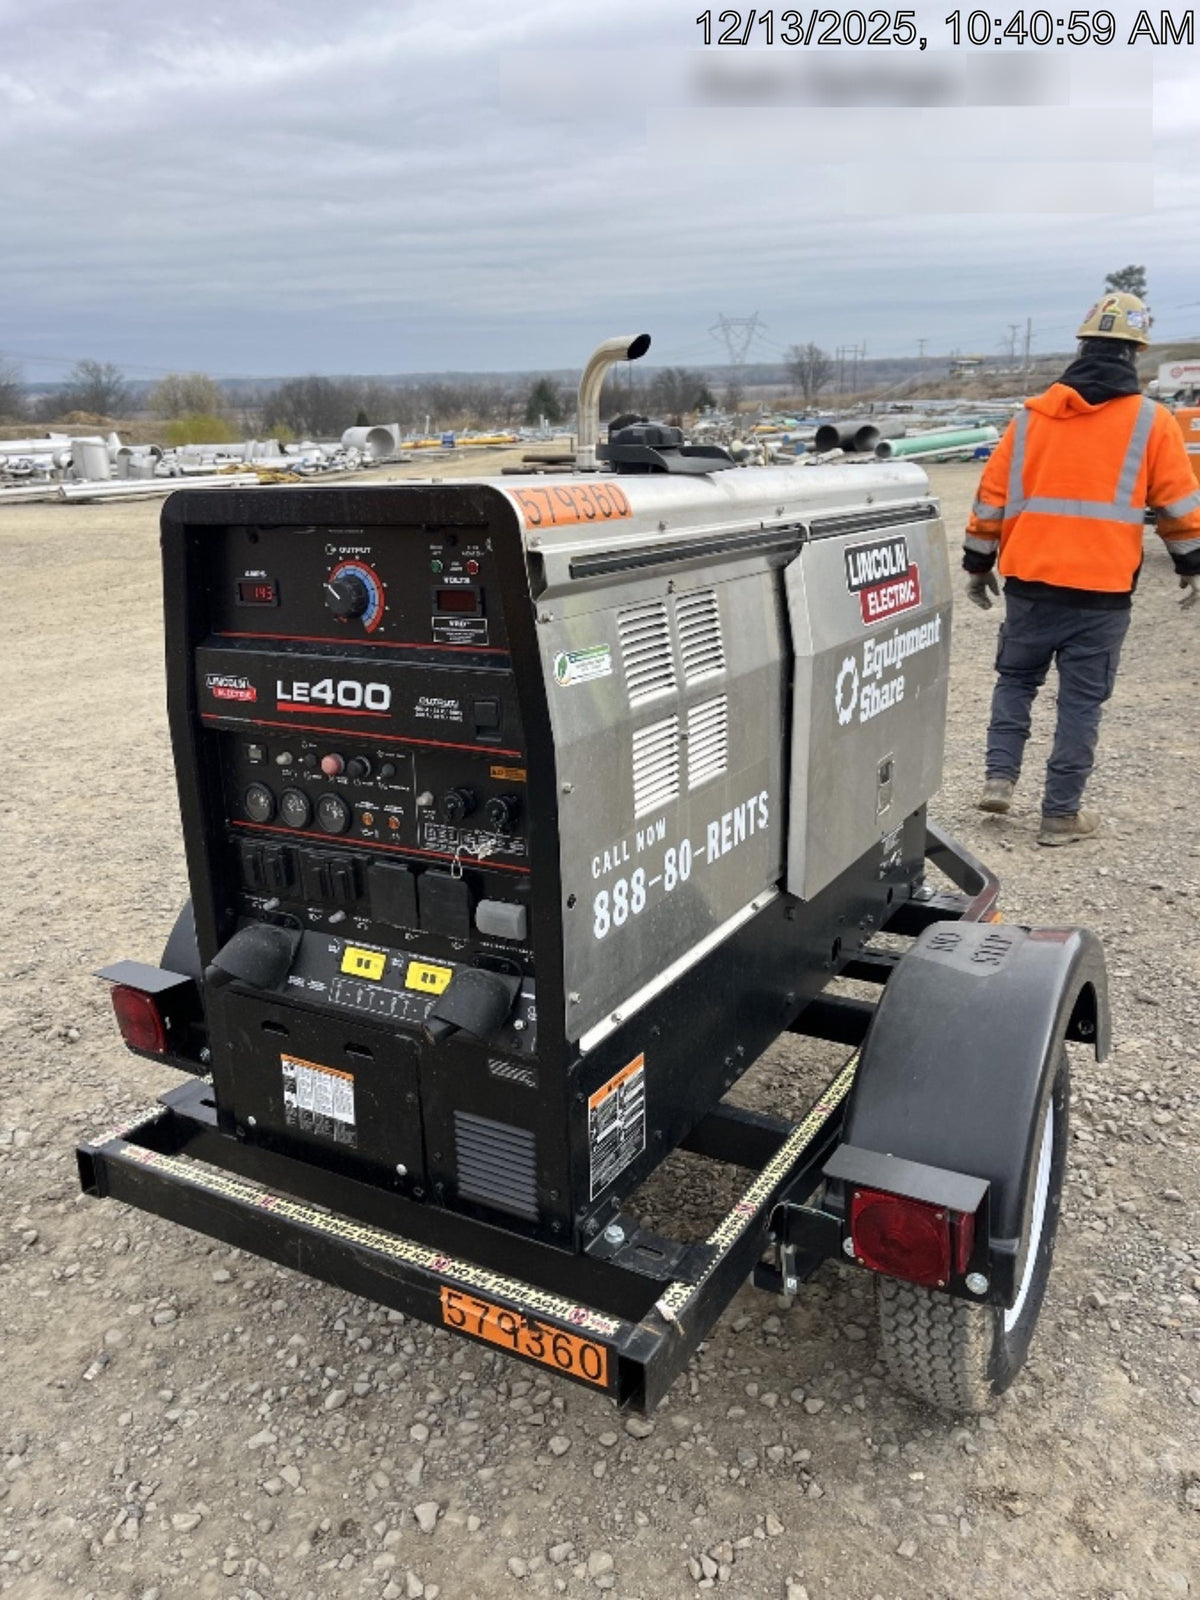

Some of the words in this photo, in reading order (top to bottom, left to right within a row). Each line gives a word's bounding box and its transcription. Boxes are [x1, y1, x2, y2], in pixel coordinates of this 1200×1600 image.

[512, 483, 629, 526] 579360
[846, 543, 907, 587] LINCOLN
[867, 579, 916, 617] ELECTRIC
[862, 614, 942, 679] Equipment
[275, 678, 392, 711] LE400
[860, 675, 906, 723] Share
[591, 840, 631, 880] CALL
[635, 817, 667, 853] NOW
[593, 790, 769, 940] 888-80-RENTS
[356, 1232, 411, 1255] DEBOUT
[449, 1264, 470, 1277] NO
[530, 1294, 569, 1315] AQUI
